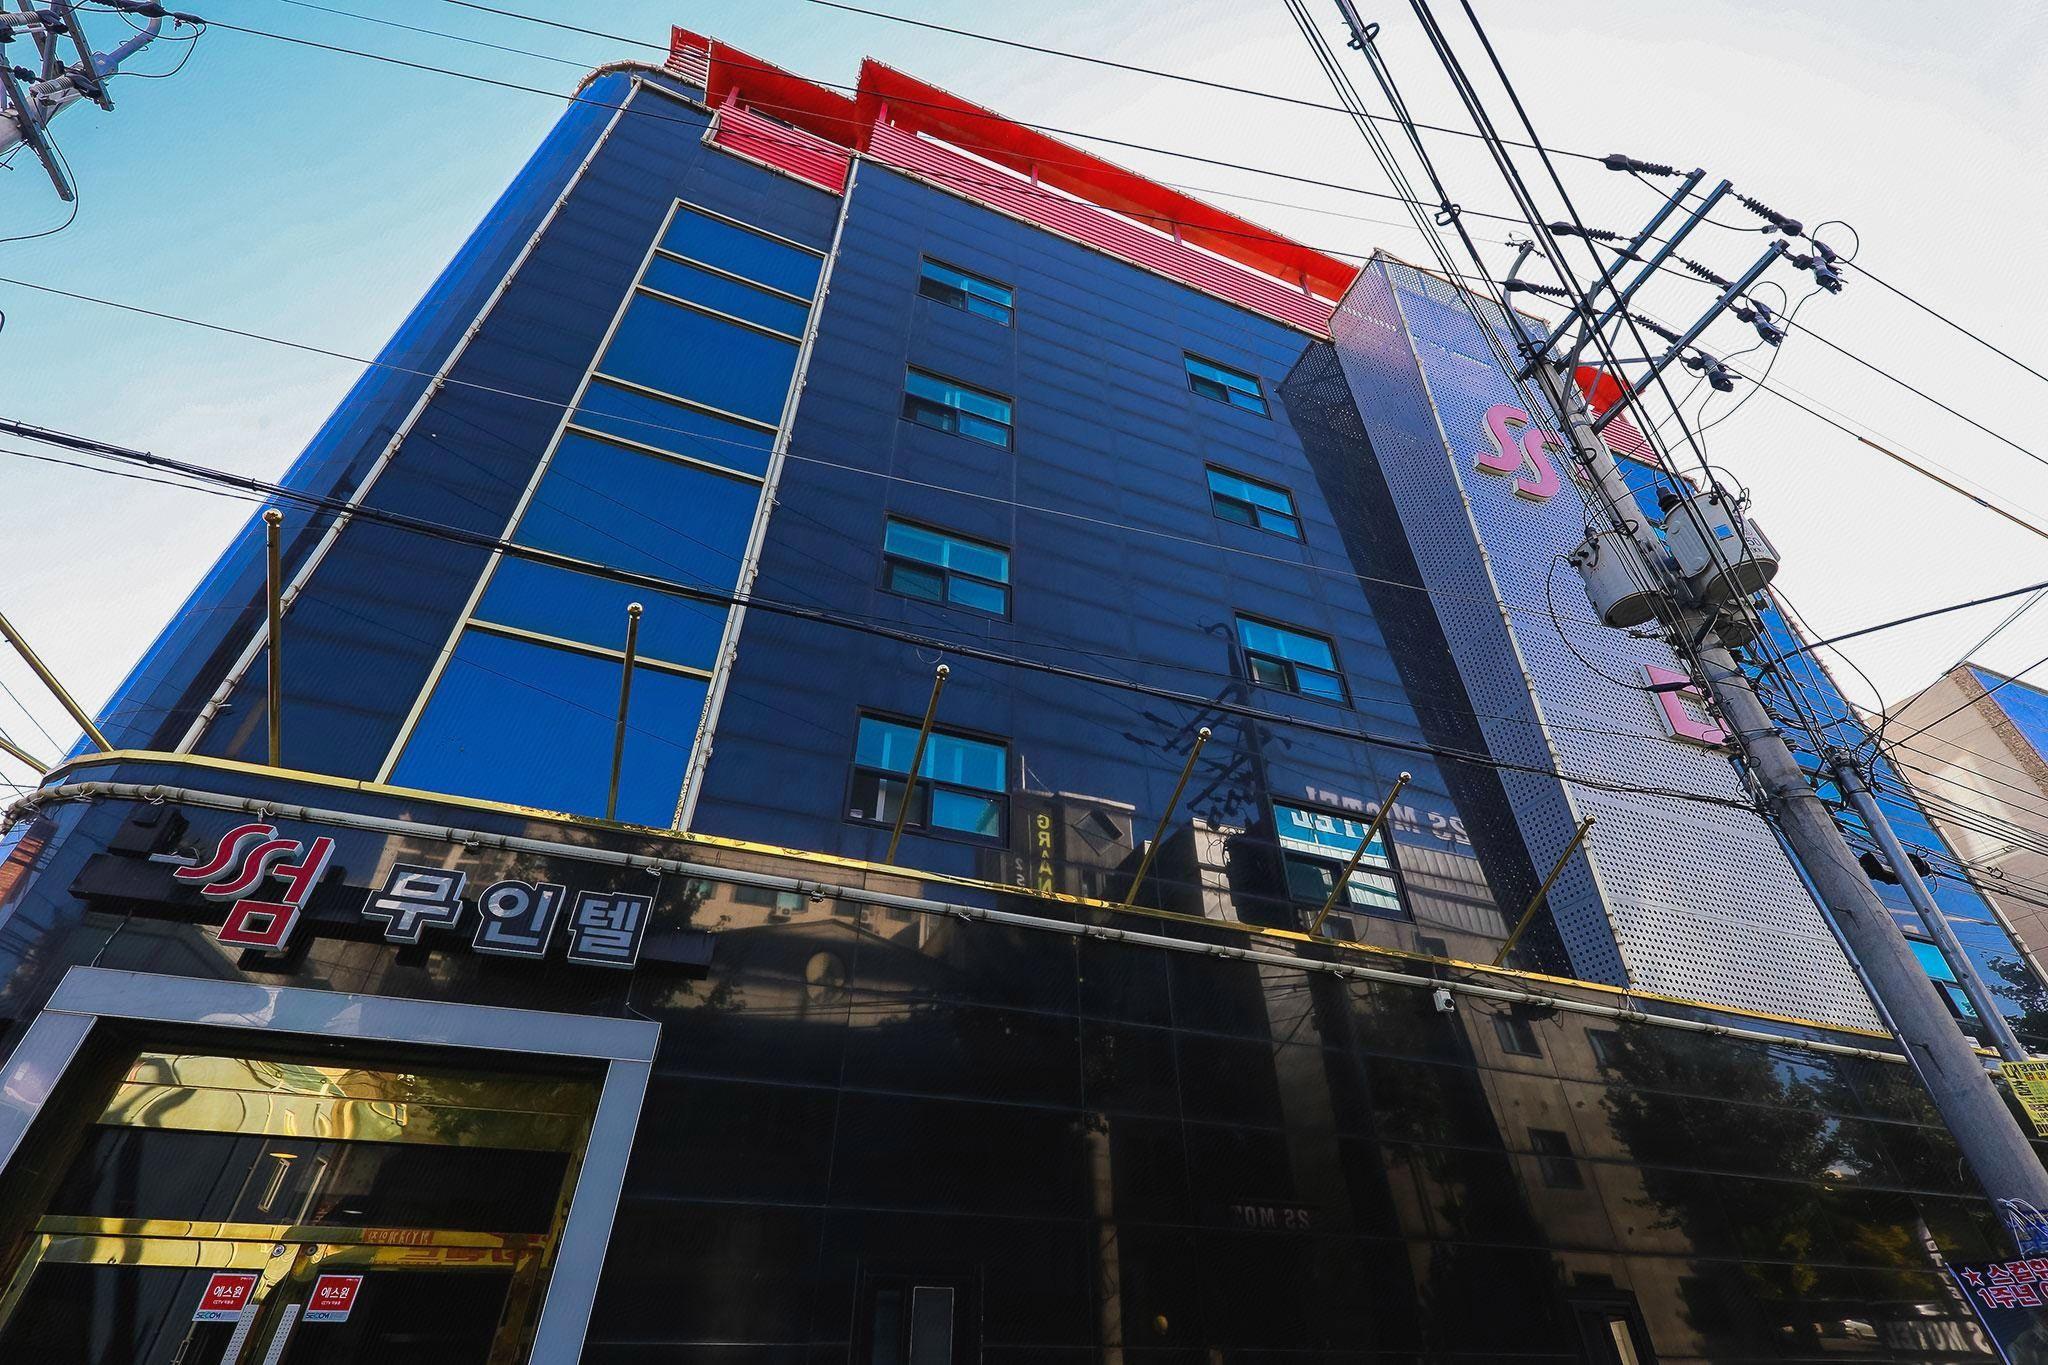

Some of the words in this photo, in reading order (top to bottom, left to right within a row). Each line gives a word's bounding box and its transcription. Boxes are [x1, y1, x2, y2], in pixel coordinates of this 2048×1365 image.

[173, 823, 335, 952] 썸
[362, 863, 653, 968] 무인텔
[213, 1285, 244, 1298] 에스원
[321, 1286, 350, 1299] 에스원
[1977, 1283, 2043, 1309] 1주년
